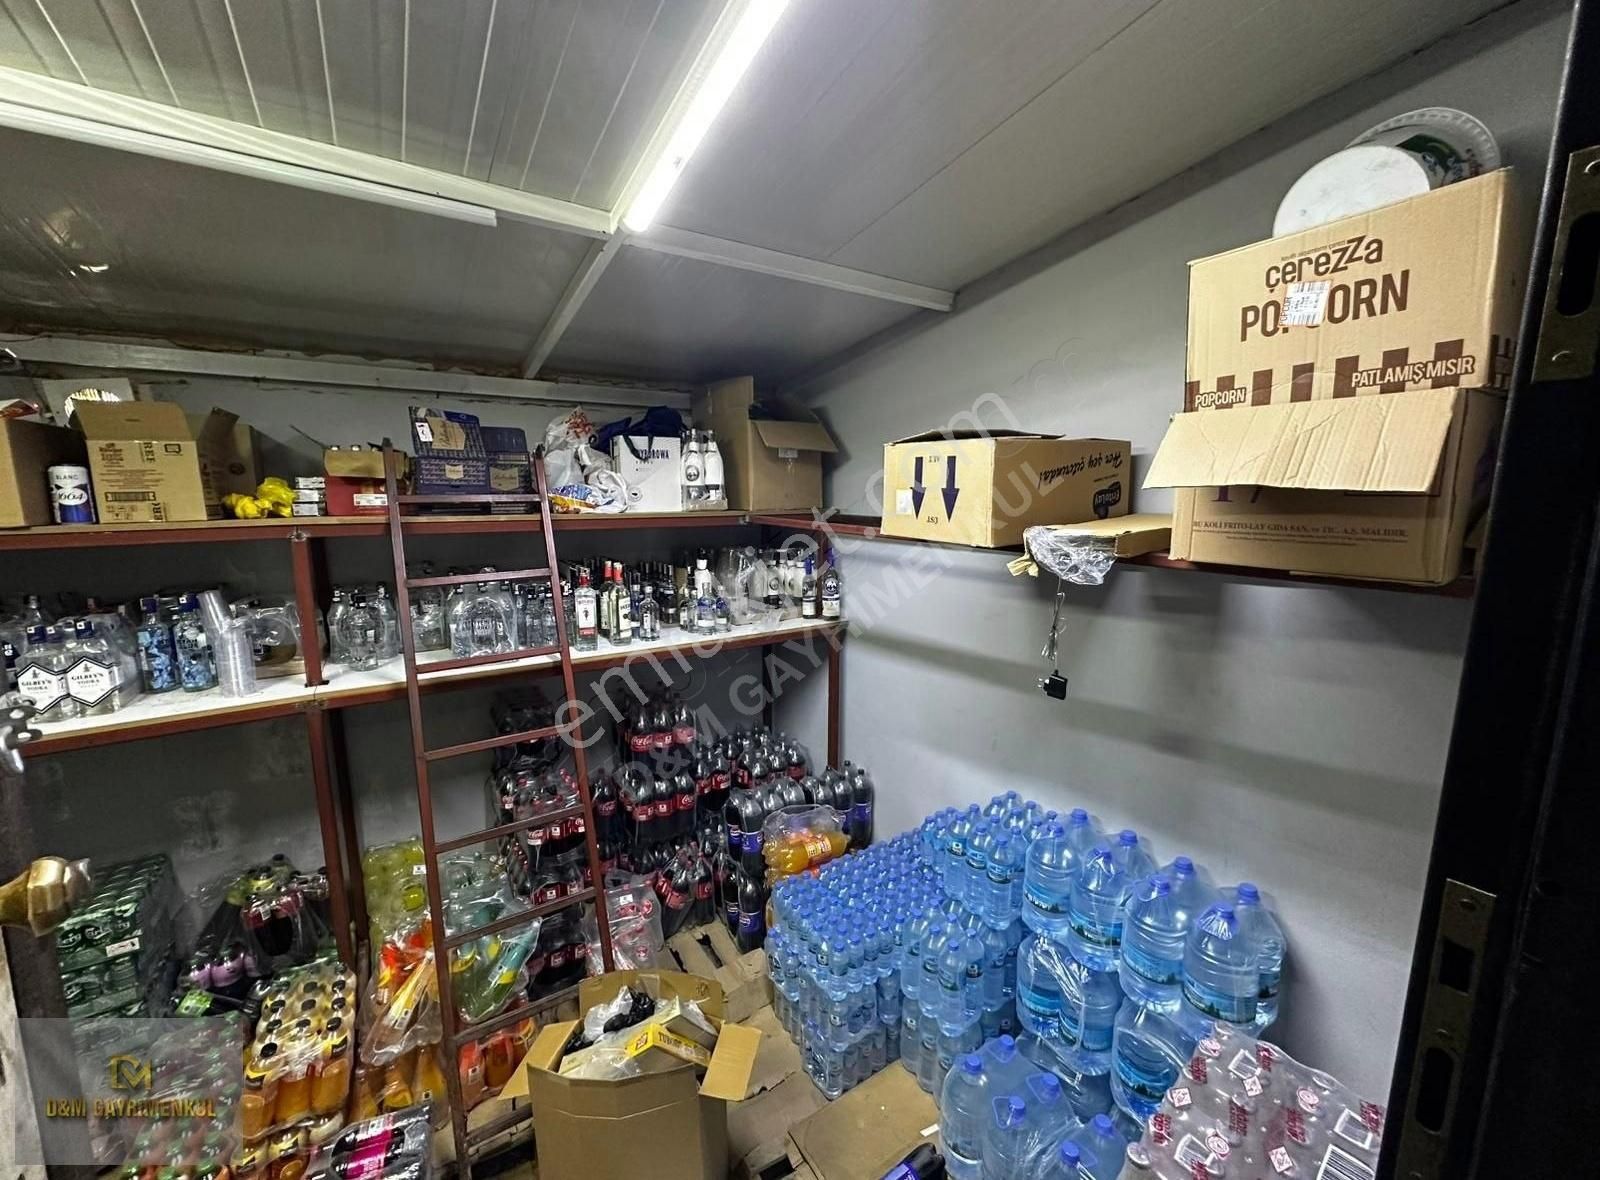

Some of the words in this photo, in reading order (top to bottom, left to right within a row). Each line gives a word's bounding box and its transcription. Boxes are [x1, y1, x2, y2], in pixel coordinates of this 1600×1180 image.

[1240, 268, 1411, 343] POORN
[1350, 364, 1424, 388] PATLAMIŞ
[1425, 355, 1476, 378] MISIR
[1194, 388, 1246, 409] POPCORN
